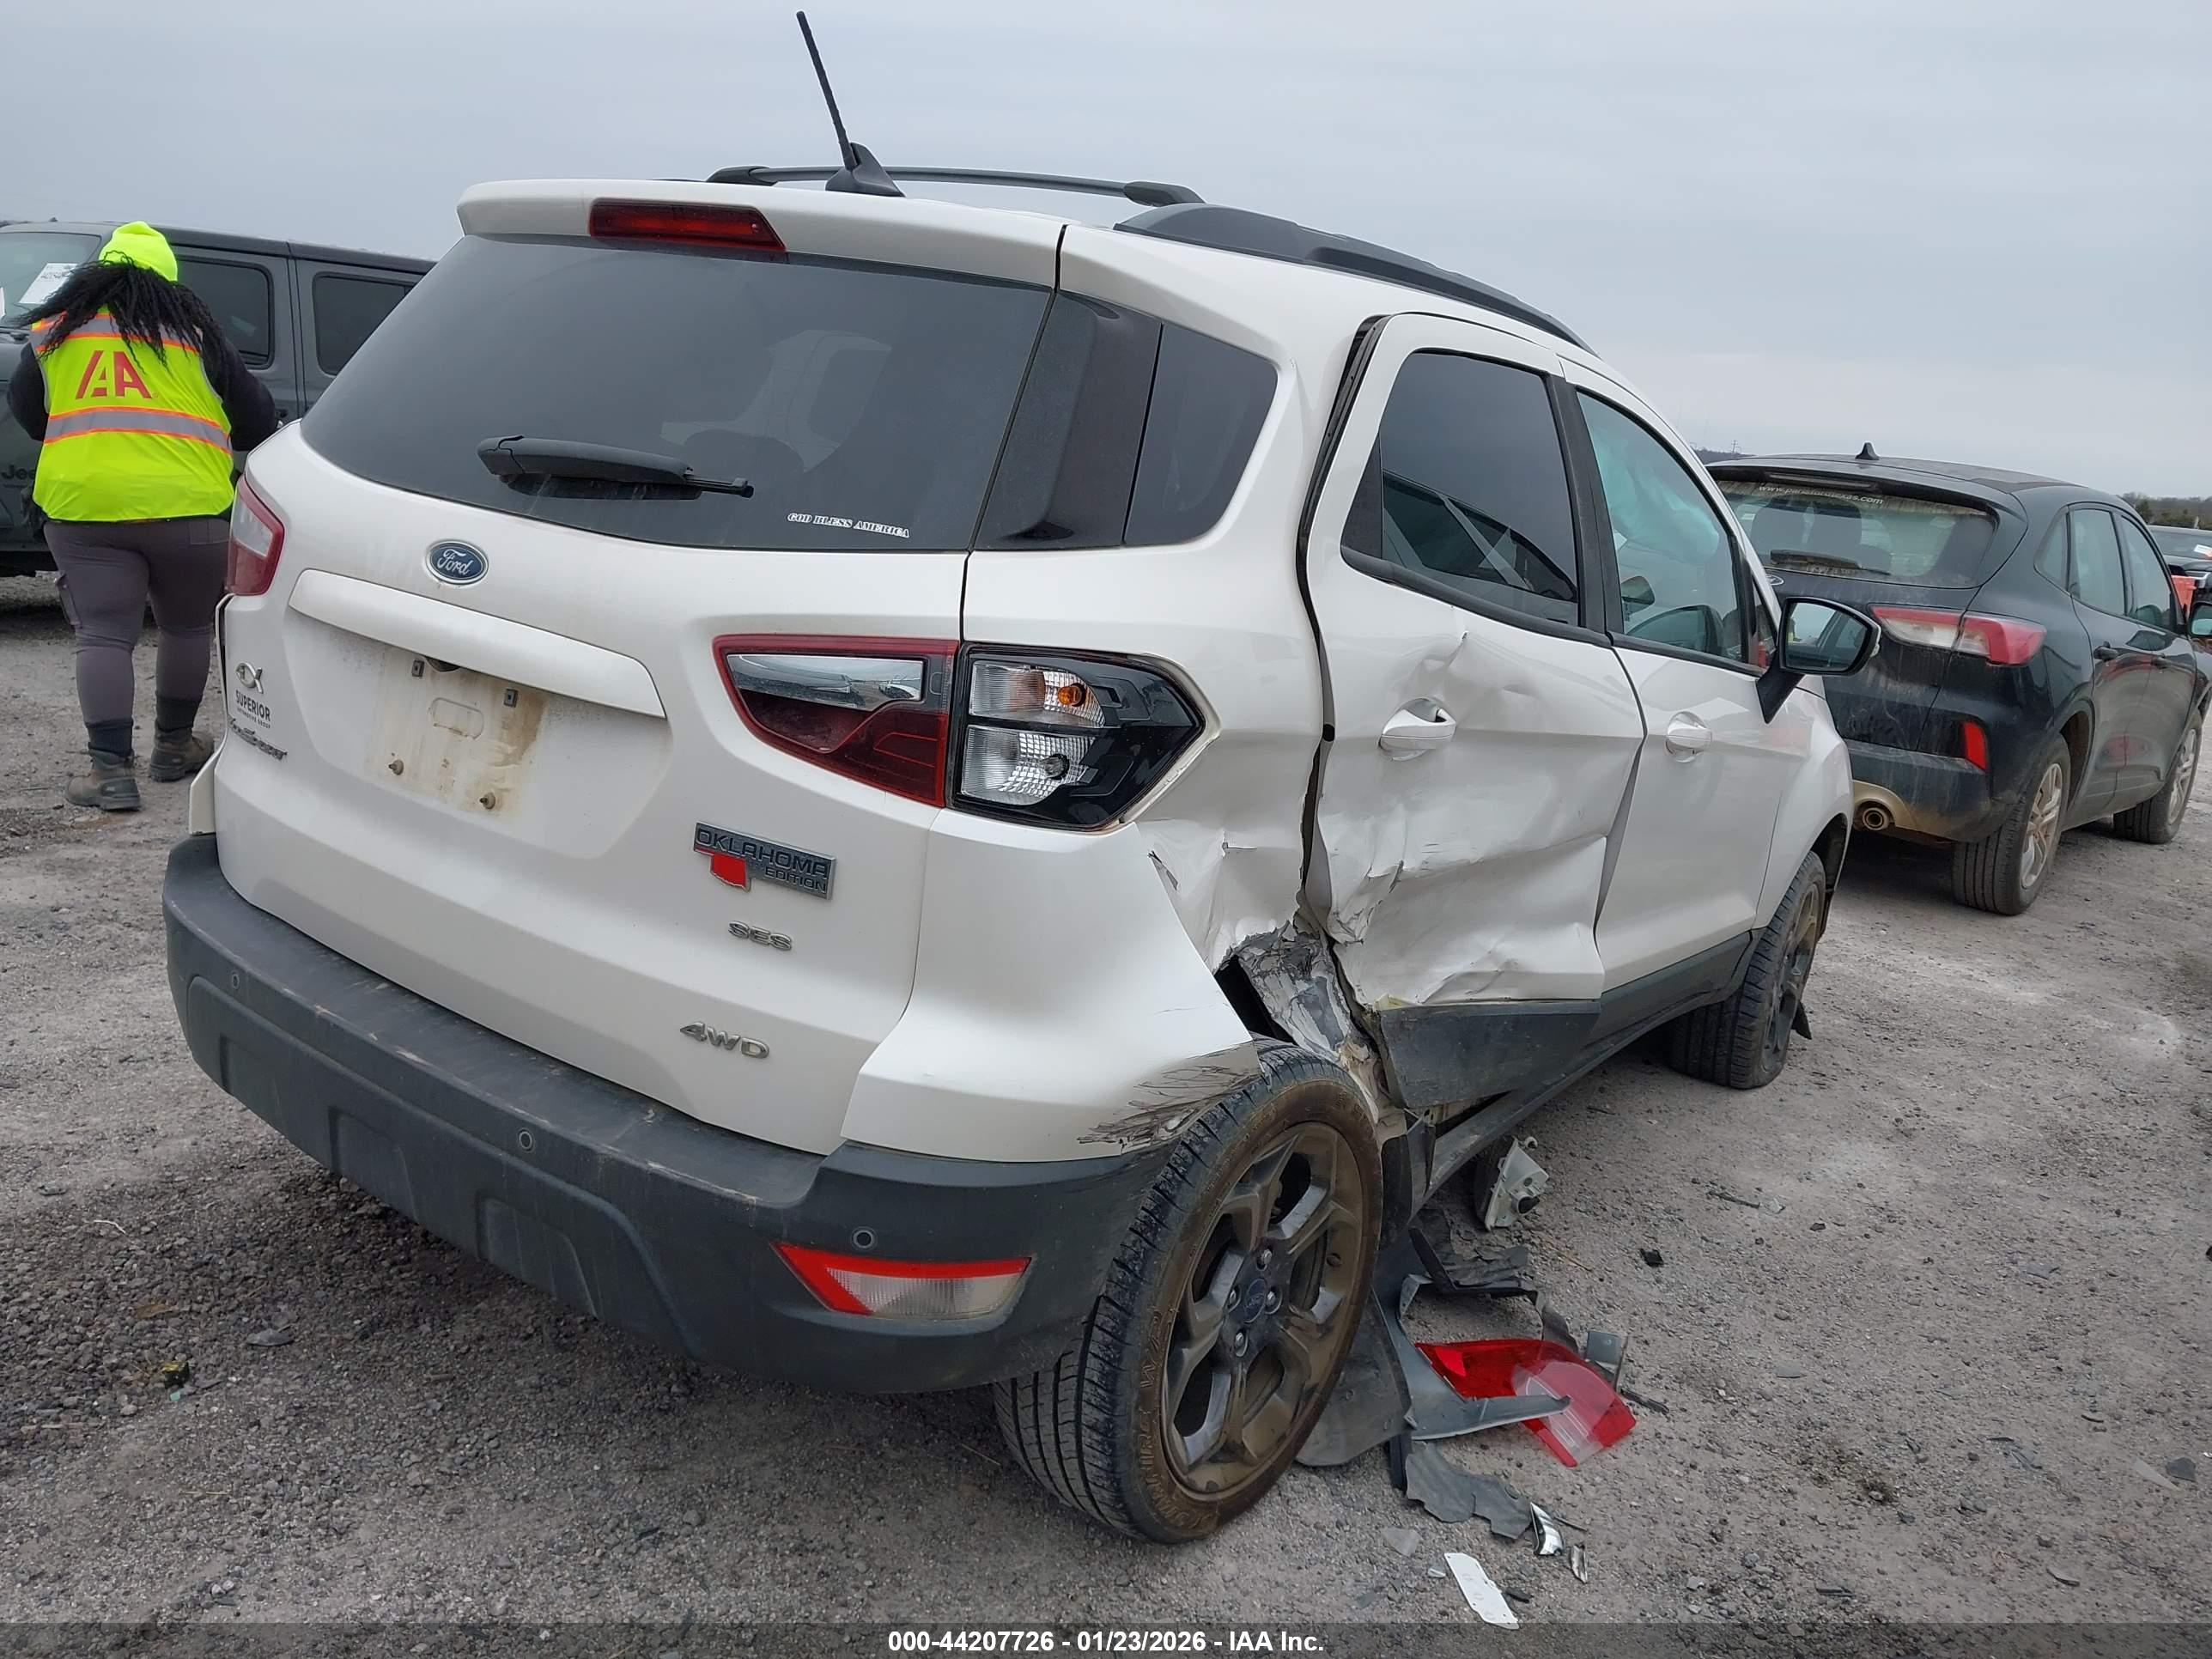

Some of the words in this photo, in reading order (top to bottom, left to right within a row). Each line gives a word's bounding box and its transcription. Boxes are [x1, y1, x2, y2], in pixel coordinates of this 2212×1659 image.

[787, 513, 812, 524] GOD
[812, 515, 853, 529] BLESS
[854, 520, 910, 538] AMERICA
[436, 548, 474, 576] Ford
[234, 690, 271, 722] SUPERIOR
[696, 826, 830, 880] OKLAHOMA
[764, 866, 828, 895] EDITION
[727, 920, 793, 952] SES
[679, 1020, 771, 1060] 4WD
